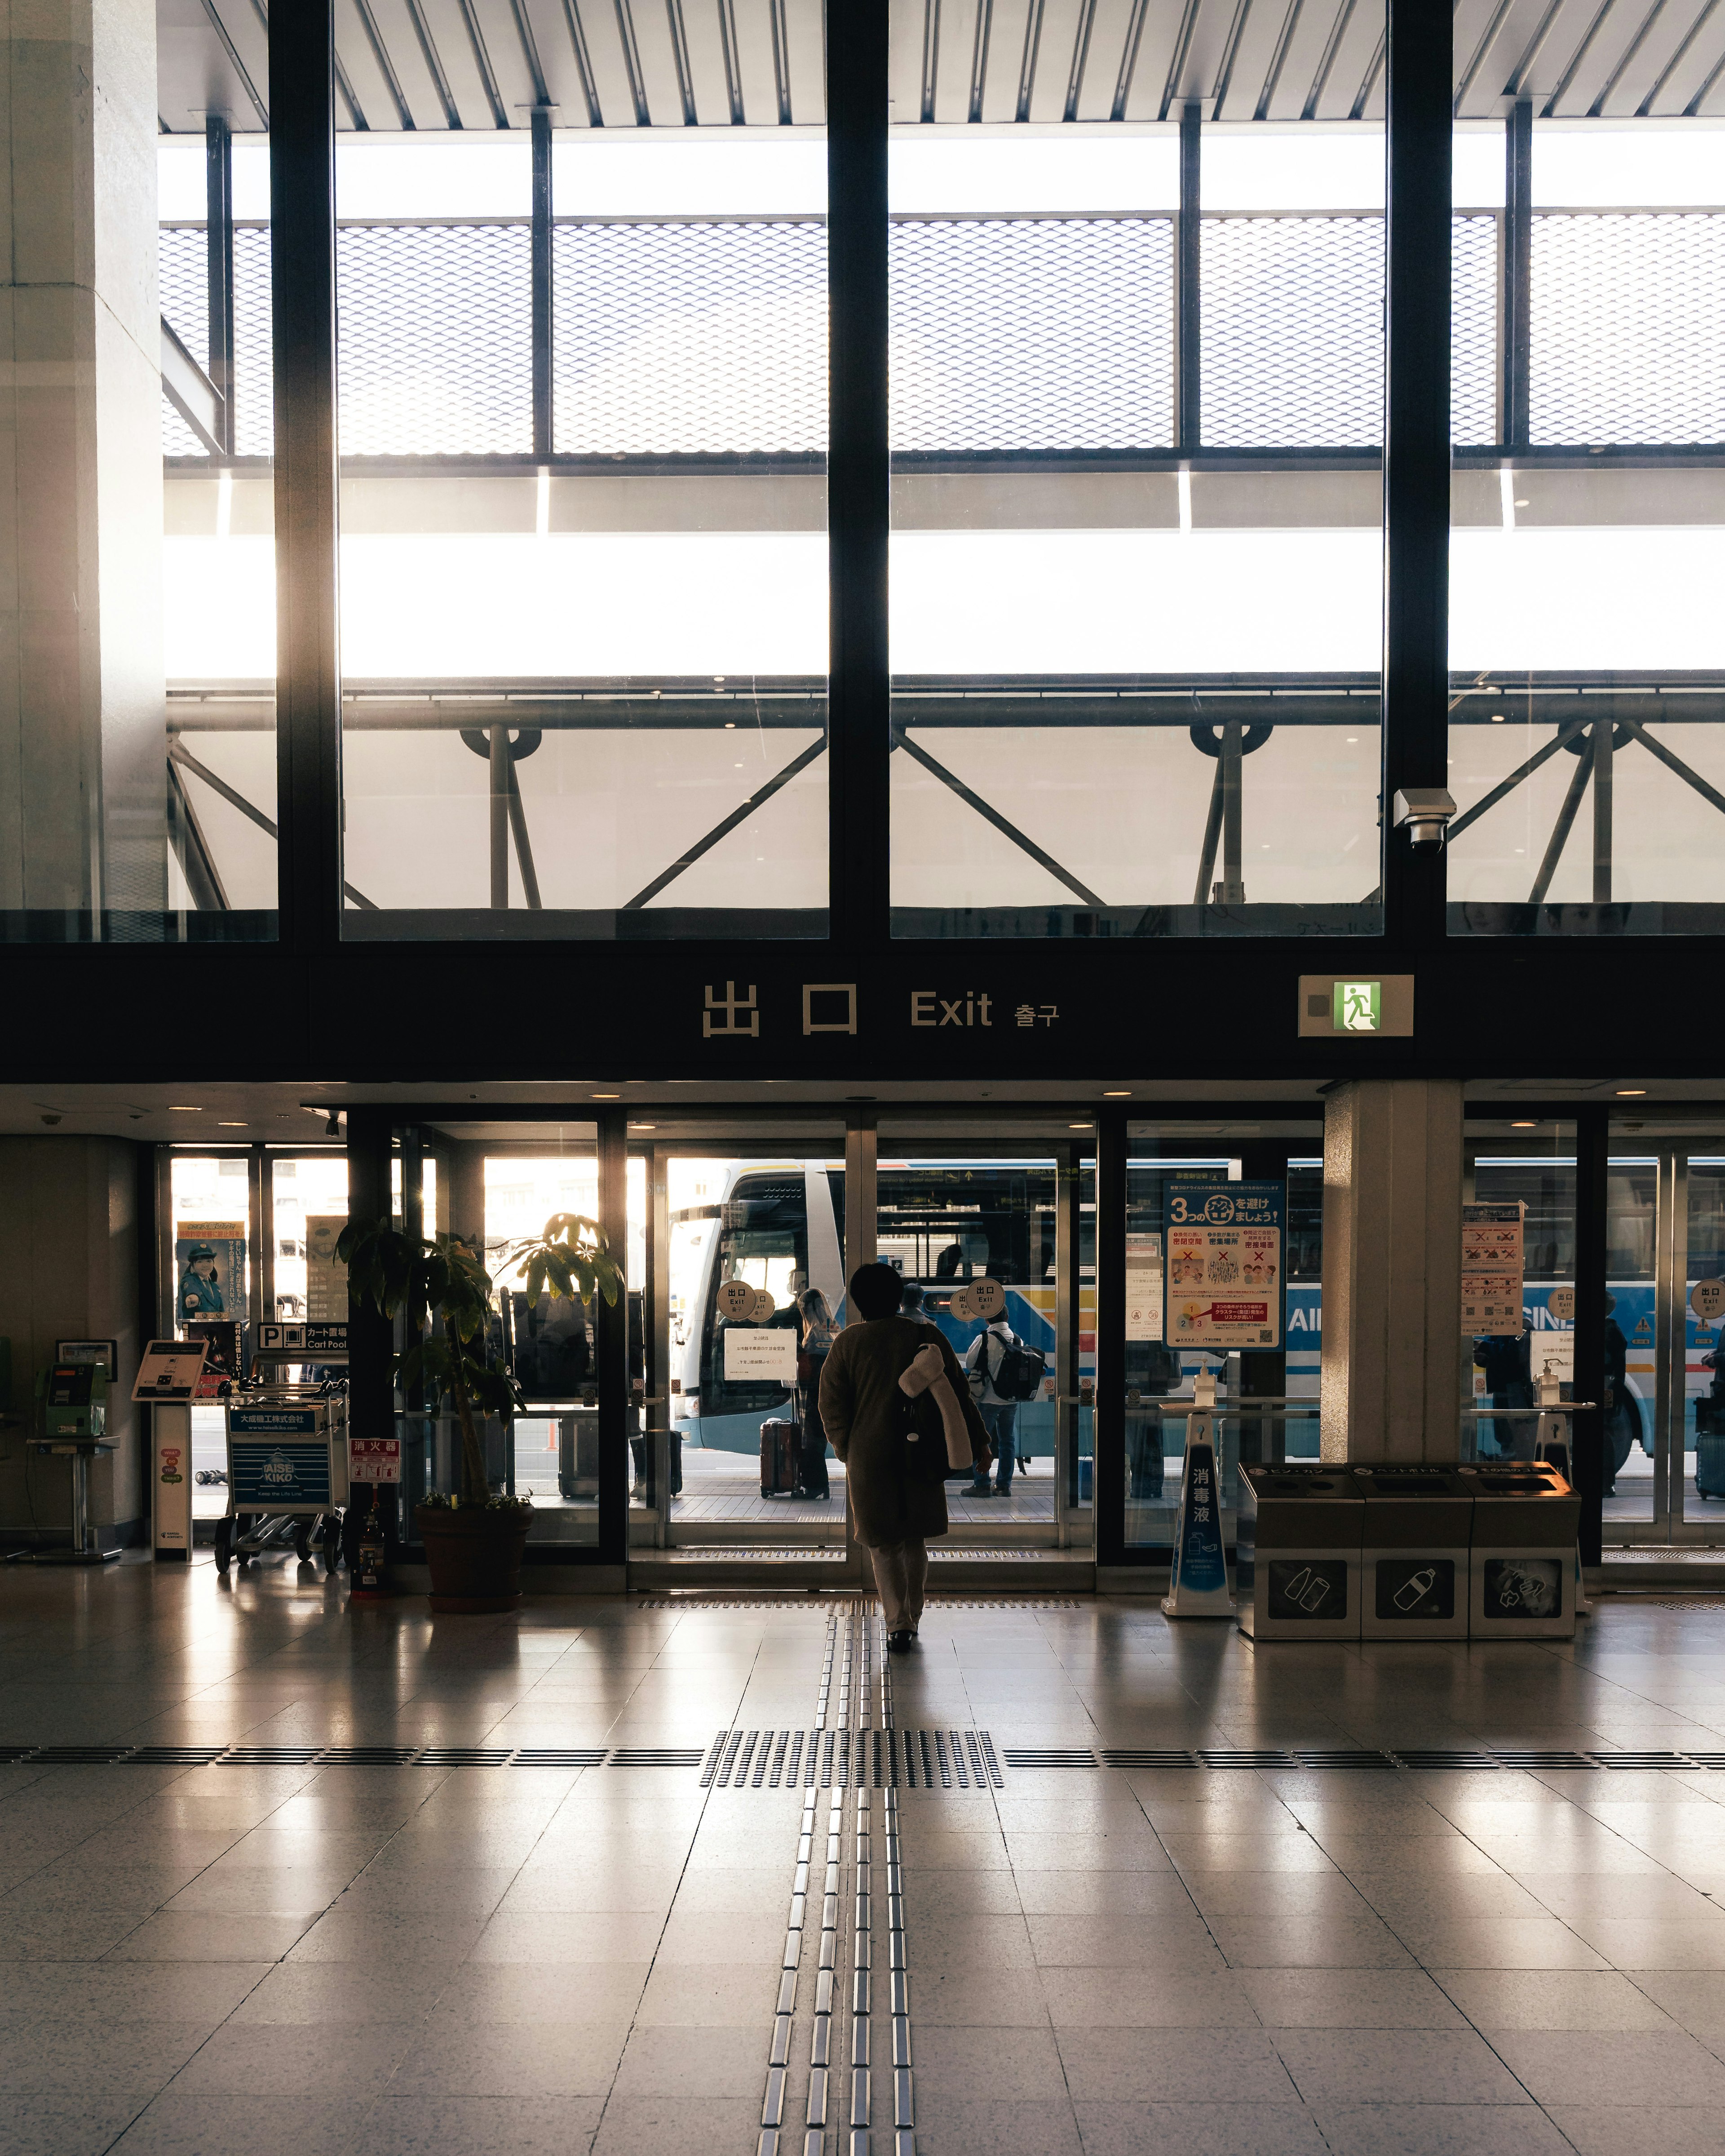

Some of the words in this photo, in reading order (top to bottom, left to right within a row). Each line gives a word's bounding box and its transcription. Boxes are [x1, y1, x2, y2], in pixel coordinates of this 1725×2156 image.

[911, 991, 992, 1026] Exit
[1014, 1004, 1060, 1027] 출구
[728, 1289, 746, 1297] 出口
[308, 1328, 347, 1337] カート置場
[265, 1328, 279, 1347] P
[308, 1340, 327, 1348] Cart
[328, 1340, 347, 1348] Pool
[241, 1415, 304, 1423] 大成機工株式会社
[264, 1463, 294, 1473] TAISEI
[265, 1473, 292, 1482] KIKO
[1193, 1468, 1210, 1522] 消毒液
